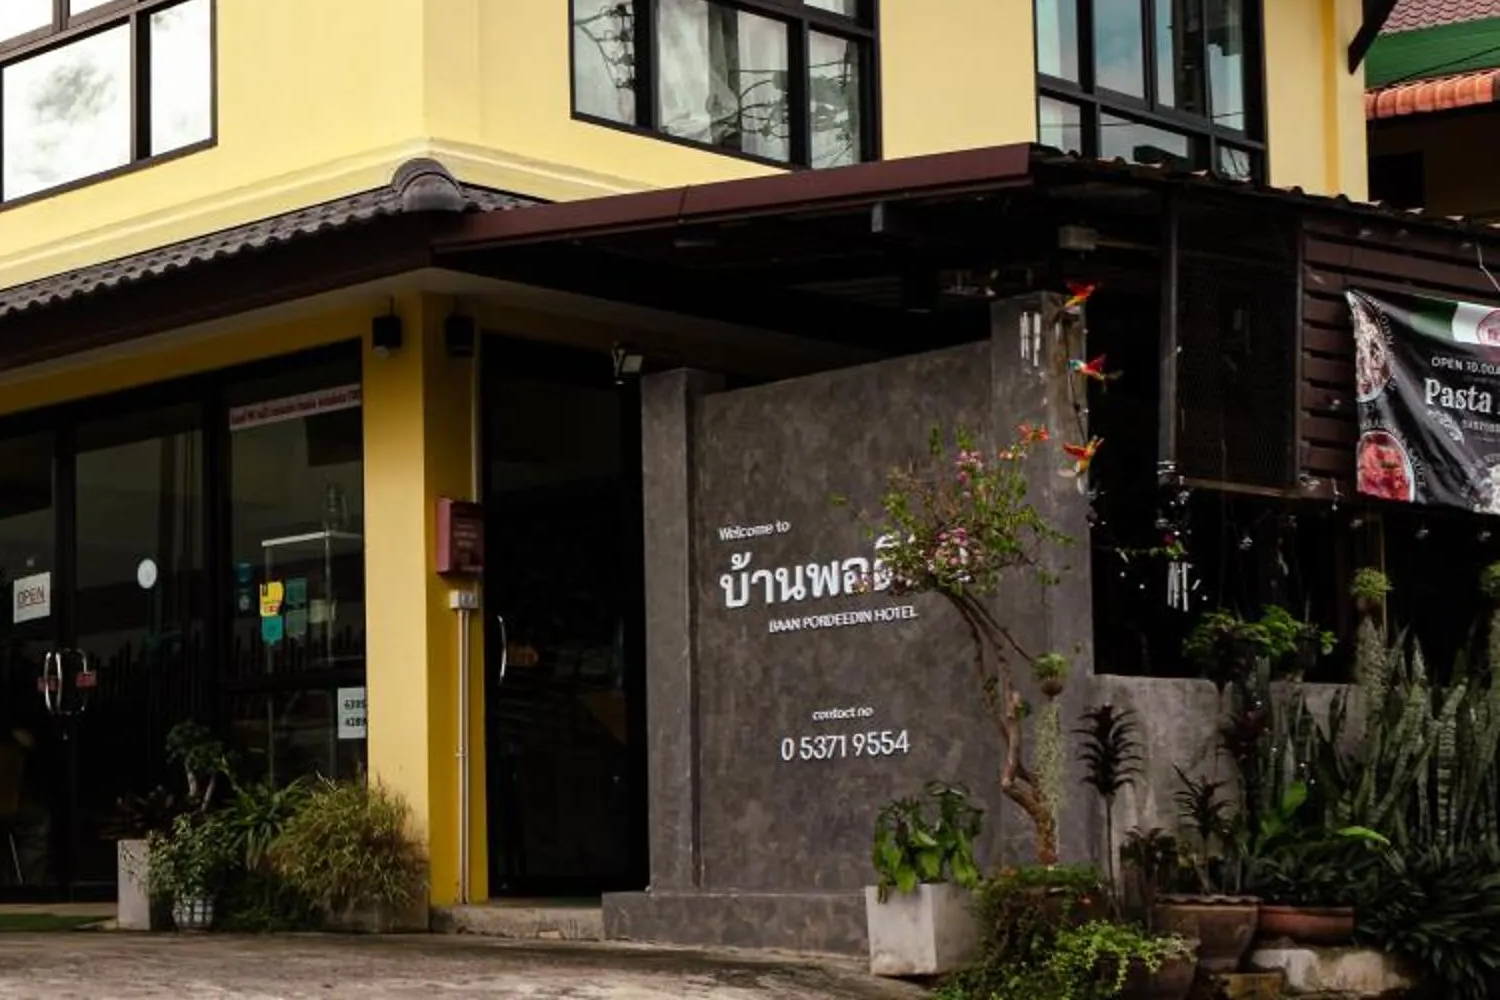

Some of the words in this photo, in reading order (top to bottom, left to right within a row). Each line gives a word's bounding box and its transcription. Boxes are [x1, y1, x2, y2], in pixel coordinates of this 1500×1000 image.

[1431, 356, 1463, 371] OPEN
[1424, 377, 1493, 414] Pasta
[718, 523, 774, 541] Welcome
[775, 519, 792, 534] to
[18, 585, 45, 605] OPEN
[768, 616, 801, 634] BAAN
[873, 604, 919, 622] HOTEL
[781, 737, 796, 761] 0
[799, 734, 847, 760] 5371
[852, 728, 911, 757] 9554
